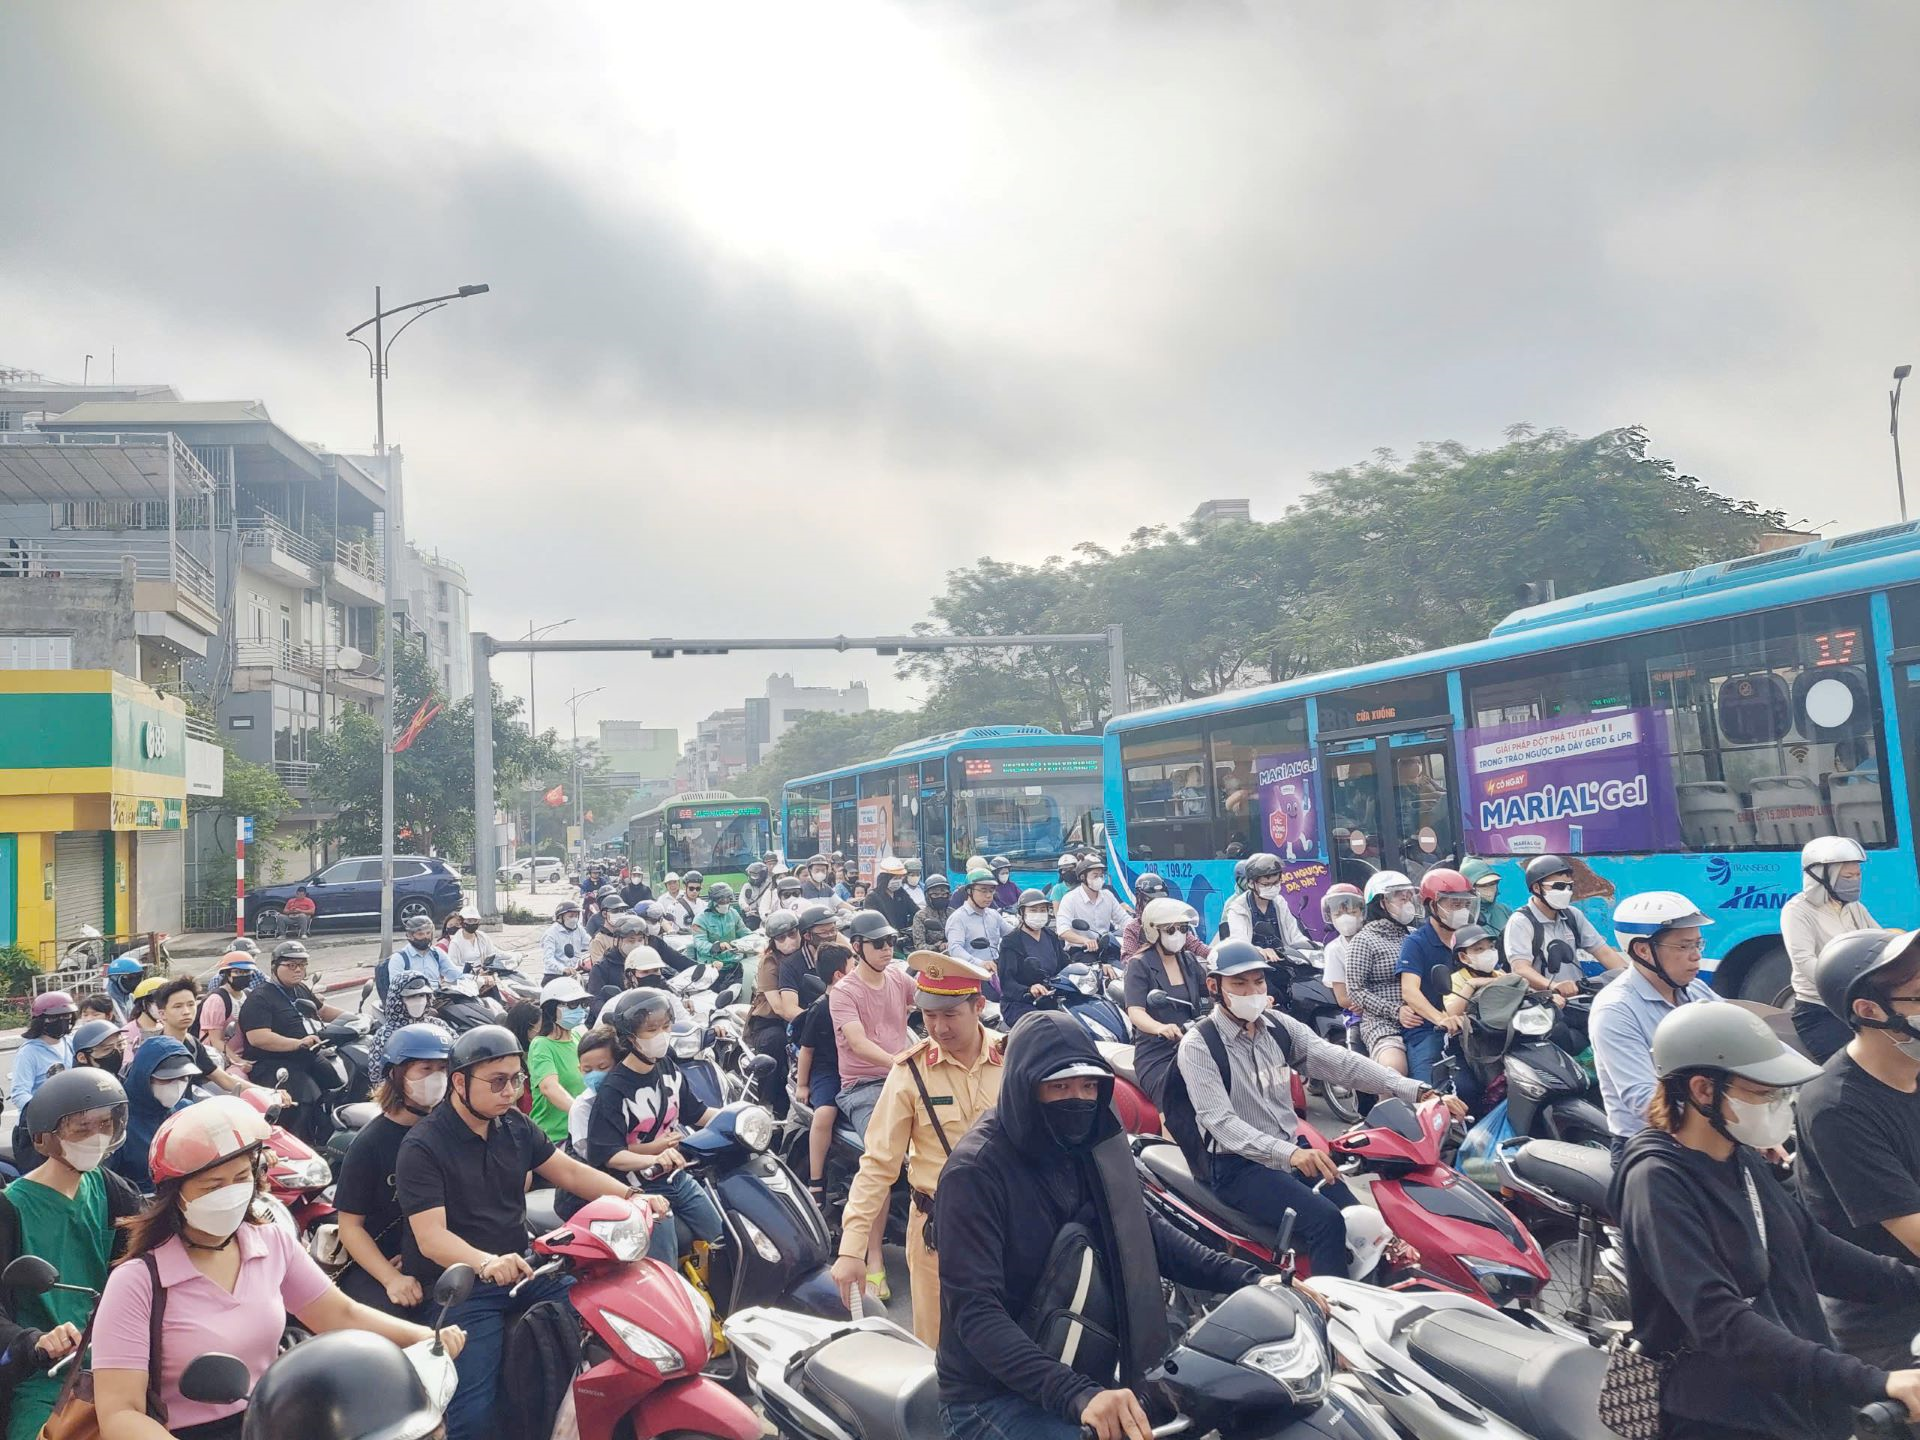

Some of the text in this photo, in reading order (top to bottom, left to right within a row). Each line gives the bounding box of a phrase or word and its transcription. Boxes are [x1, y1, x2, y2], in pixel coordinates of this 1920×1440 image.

[1512, 739, 1531, 752] PHÁP
[1579, 725, 1601, 738] ITALY
[1479, 756, 1503, 768] TRONG
[1504, 751, 1524, 764] TRÀO
[1525, 746, 1553, 760] NGƯỢC
[1585, 736, 1607, 748] GERD
[1617, 731, 1632, 742] LPR
[1505, 774, 1525, 788] NGAY
[1166, 862, 1193, 878] 199.22
